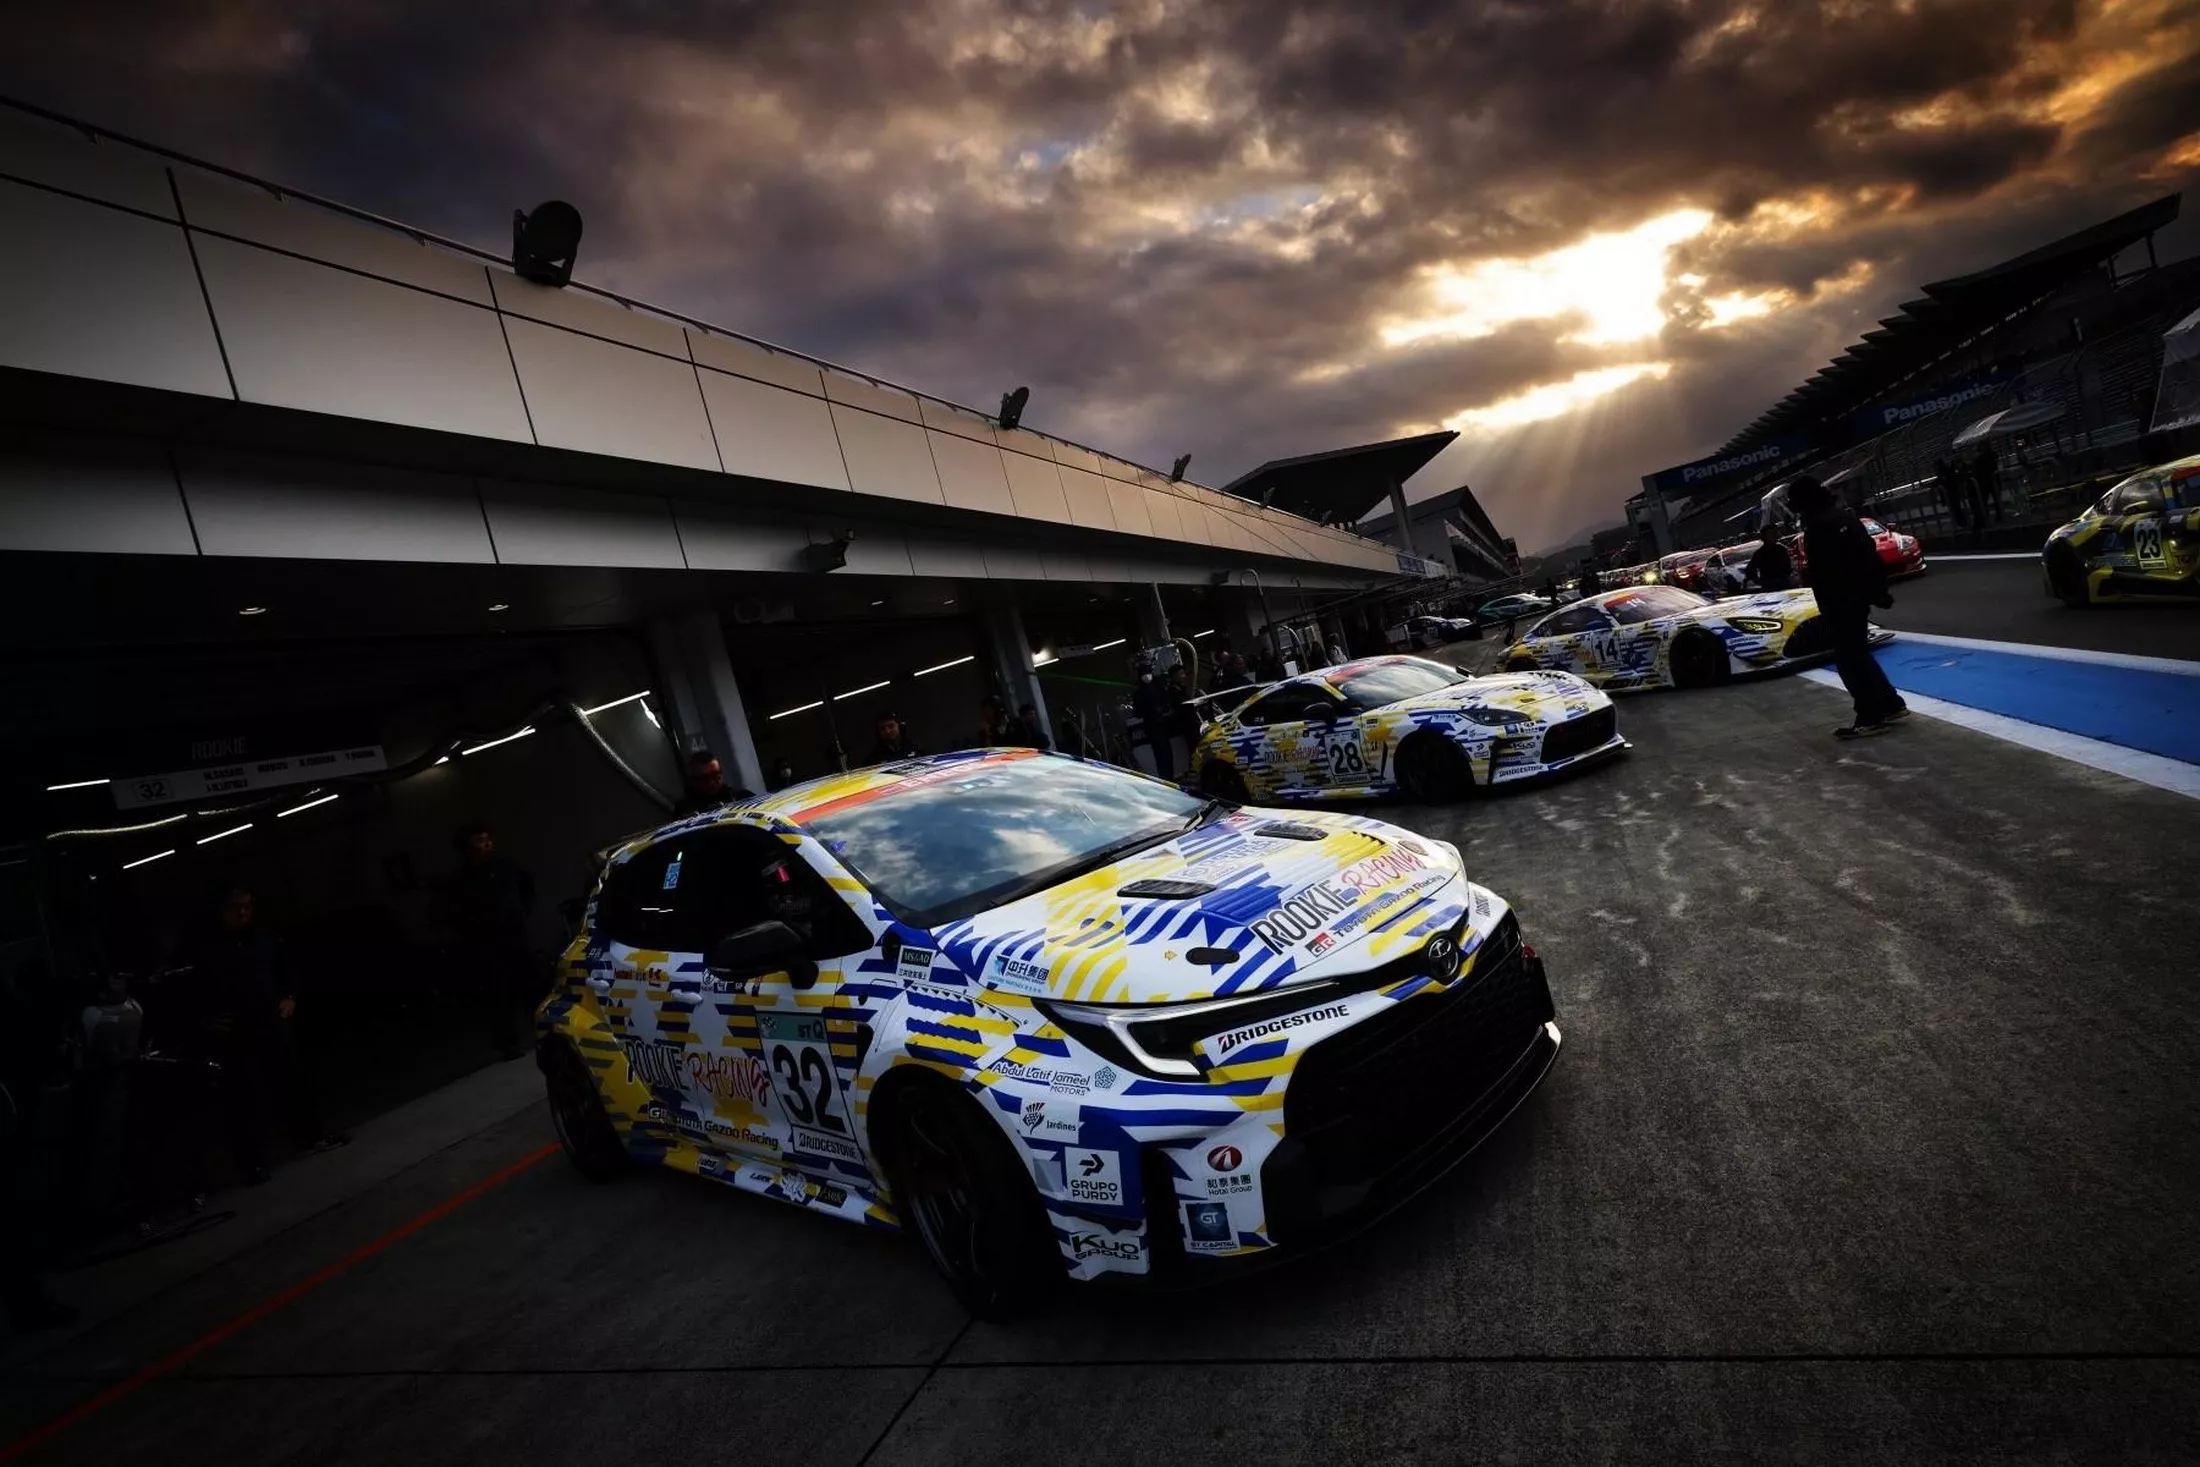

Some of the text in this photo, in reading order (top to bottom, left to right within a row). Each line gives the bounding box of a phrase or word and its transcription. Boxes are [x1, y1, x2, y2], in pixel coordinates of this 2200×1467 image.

[1882, 382, 1993, 425] Panasonic
[1682, 445, 1781, 484] Panasonic
[2137, 529, 2161, 559] 23
[1595, 638, 1618, 662] 14
[190, 736, 249, 761] ROOKIE
[1330, 742, 1363, 775] 28
[138, 781, 168, 800] 32
[1413, 873, 1446, 892] Racing
[1250, 879, 1358, 956] ROOKIE
[1340, 848, 1428, 896] RACING
[1007, 960, 1050, 981] 中升集团
[1218, 1004, 1350, 1055] BRIDGESTONE
[624, 1040, 771, 1108] ROOKIE RACING
[992, 1063, 1091, 1087] Abdul Latif Jameel
[773, 1044, 847, 1134] 32
[1049, 1085, 1086, 1097] MOTORS
[1046, 1120, 1077, 1132] Jardines
[741, 1128, 779, 1150] Racing
[799, 1133, 858, 1159] BRIDGESTONE
[1070, 1179, 1118, 1192] GRUPO
[1072, 1189, 1118, 1201] PURDY
[1208, 1184, 1253, 1196] Hotai Group
[1200, 1211, 1219, 1225] GT
